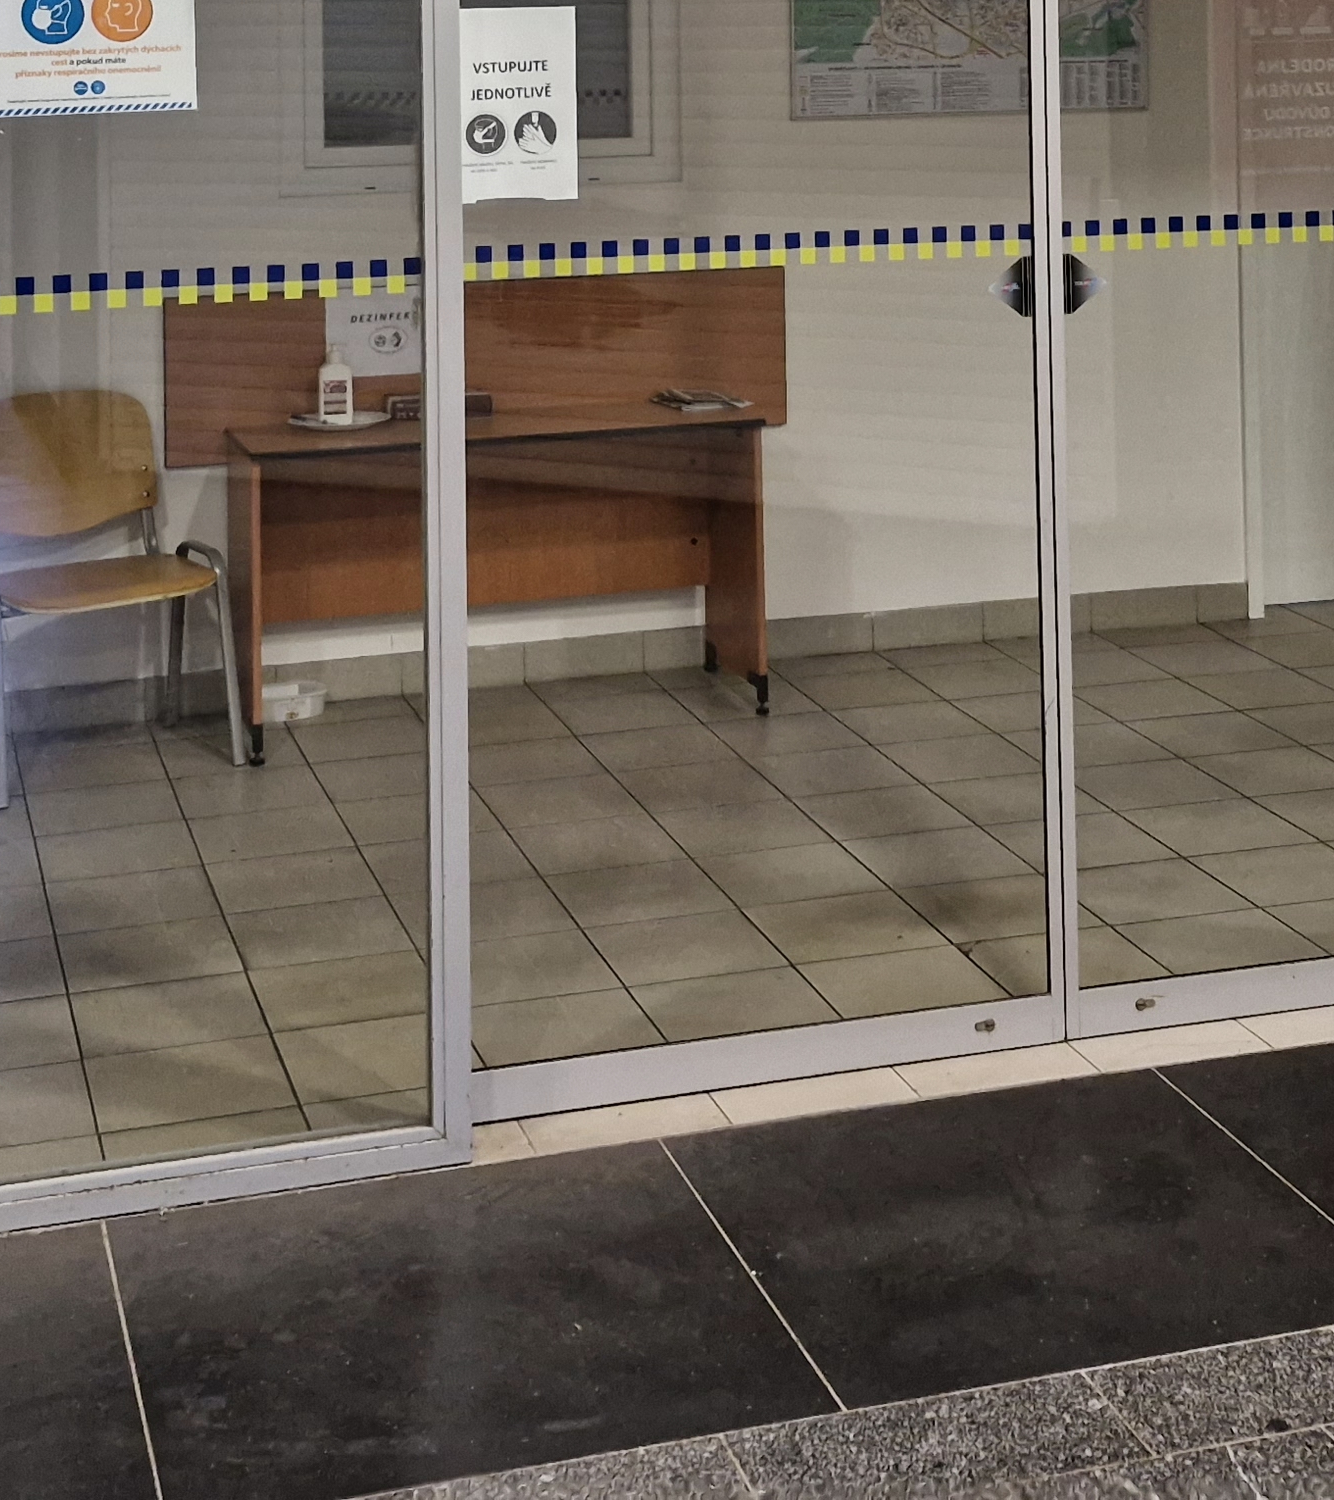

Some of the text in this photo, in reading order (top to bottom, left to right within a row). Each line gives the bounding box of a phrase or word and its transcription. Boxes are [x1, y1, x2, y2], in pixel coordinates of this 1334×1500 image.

[82, 47, 96, 55] bez
[77, 58, 103, 67] pokud
[105, 57, 126, 65] máte
[473, 60, 548, 74] VSTUPUJTE
[471, 83, 552, 101] JEDNOTLIVĚ
[351, 311, 417, 324] DEZINFEK
